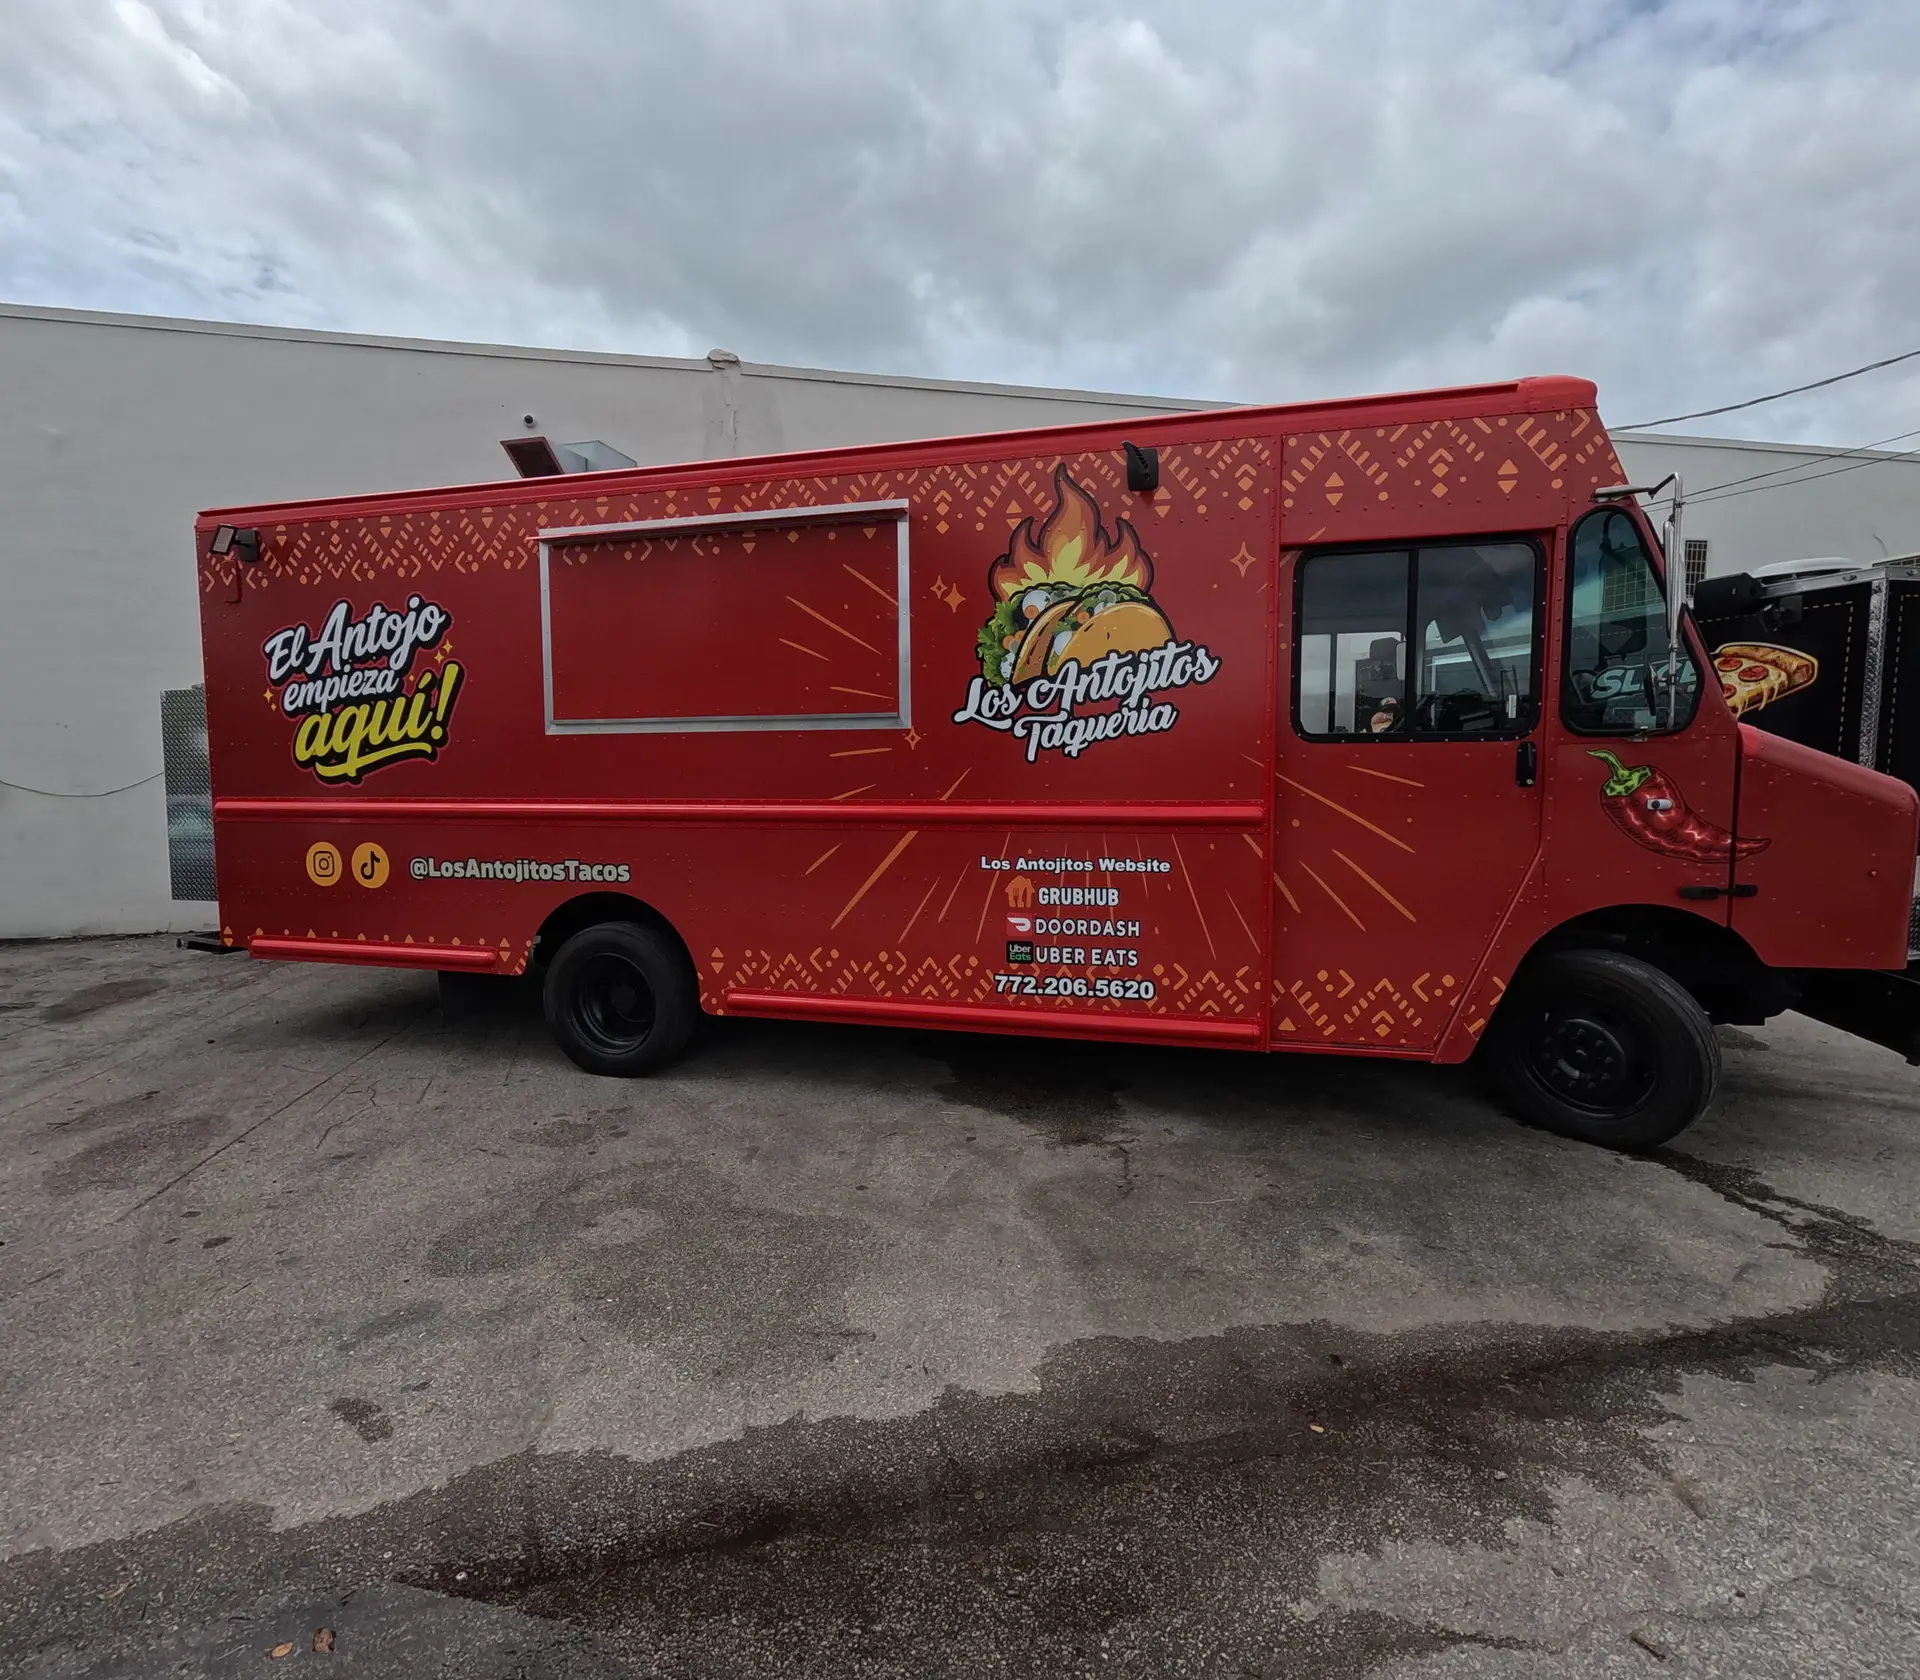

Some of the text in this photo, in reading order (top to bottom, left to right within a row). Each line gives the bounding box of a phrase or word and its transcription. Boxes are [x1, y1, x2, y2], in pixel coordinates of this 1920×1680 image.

[264, 596, 446, 681] El Antojo
[283, 664, 400, 714] empieza
[954, 641, 1219, 730] Los Antojitos
[1591, 660, 1697, 699] SLC
[295, 663, 459, 777] aquí!
[410, 858, 631, 883] @LosAntojitosTacos
[980, 856, 1171, 874] Los Antojitos Website
[1038, 887, 1120, 906] GRUBHUB
[1035, 918, 1141, 937] DOORDASH
[1009, 943, 1031, 953] Uber
[1009, 952, 1032, 961] Eats
[1036, 947, 1138, 967] UBER EATS
[994, 975, 1155, 999] 772.206.5620
